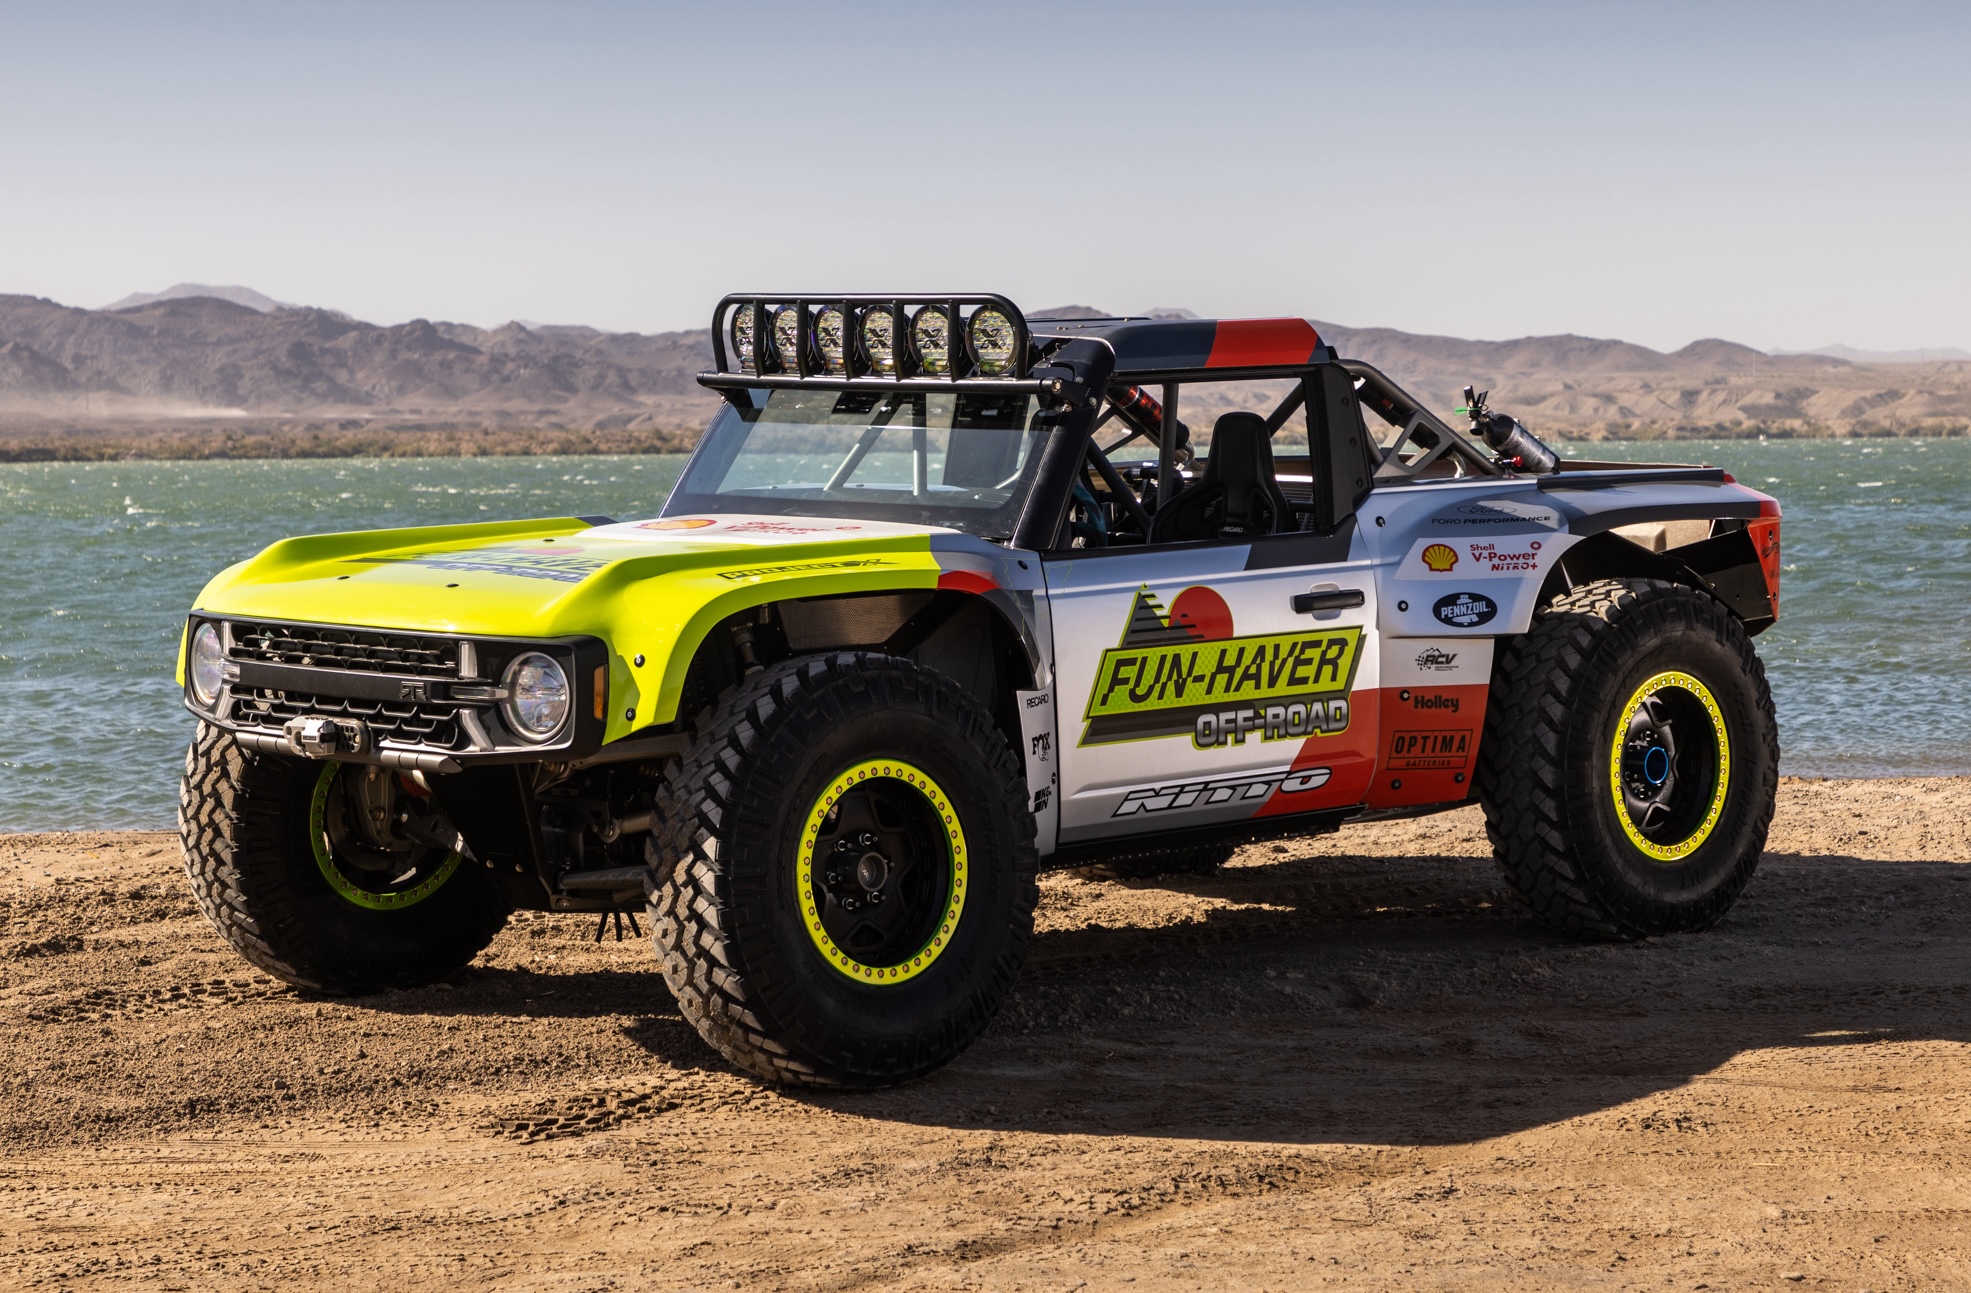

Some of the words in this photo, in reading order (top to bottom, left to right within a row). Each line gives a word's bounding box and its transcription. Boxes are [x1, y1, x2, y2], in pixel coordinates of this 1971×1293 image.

[1469, 506, 1505, 514] Ford
[1463, 516, 1551, 524] PERFORMANCE
[1470, 543, 1495, 551] Shell
[1472, 552, 1537, 562] V-Power
[1424, 653, 1458, 665] RCV
[1099, 637, 1348, 707] FUN-HAVER
[1026, 693, 1049, 709] RECARO
[1414, 695, 1459, 713] Holley
[1195, 699, 1350, 748] OFF-ROAD
[1031, 732, 1051, 757] FOX
[1394, 735, 1466, 754] OPTIMA
